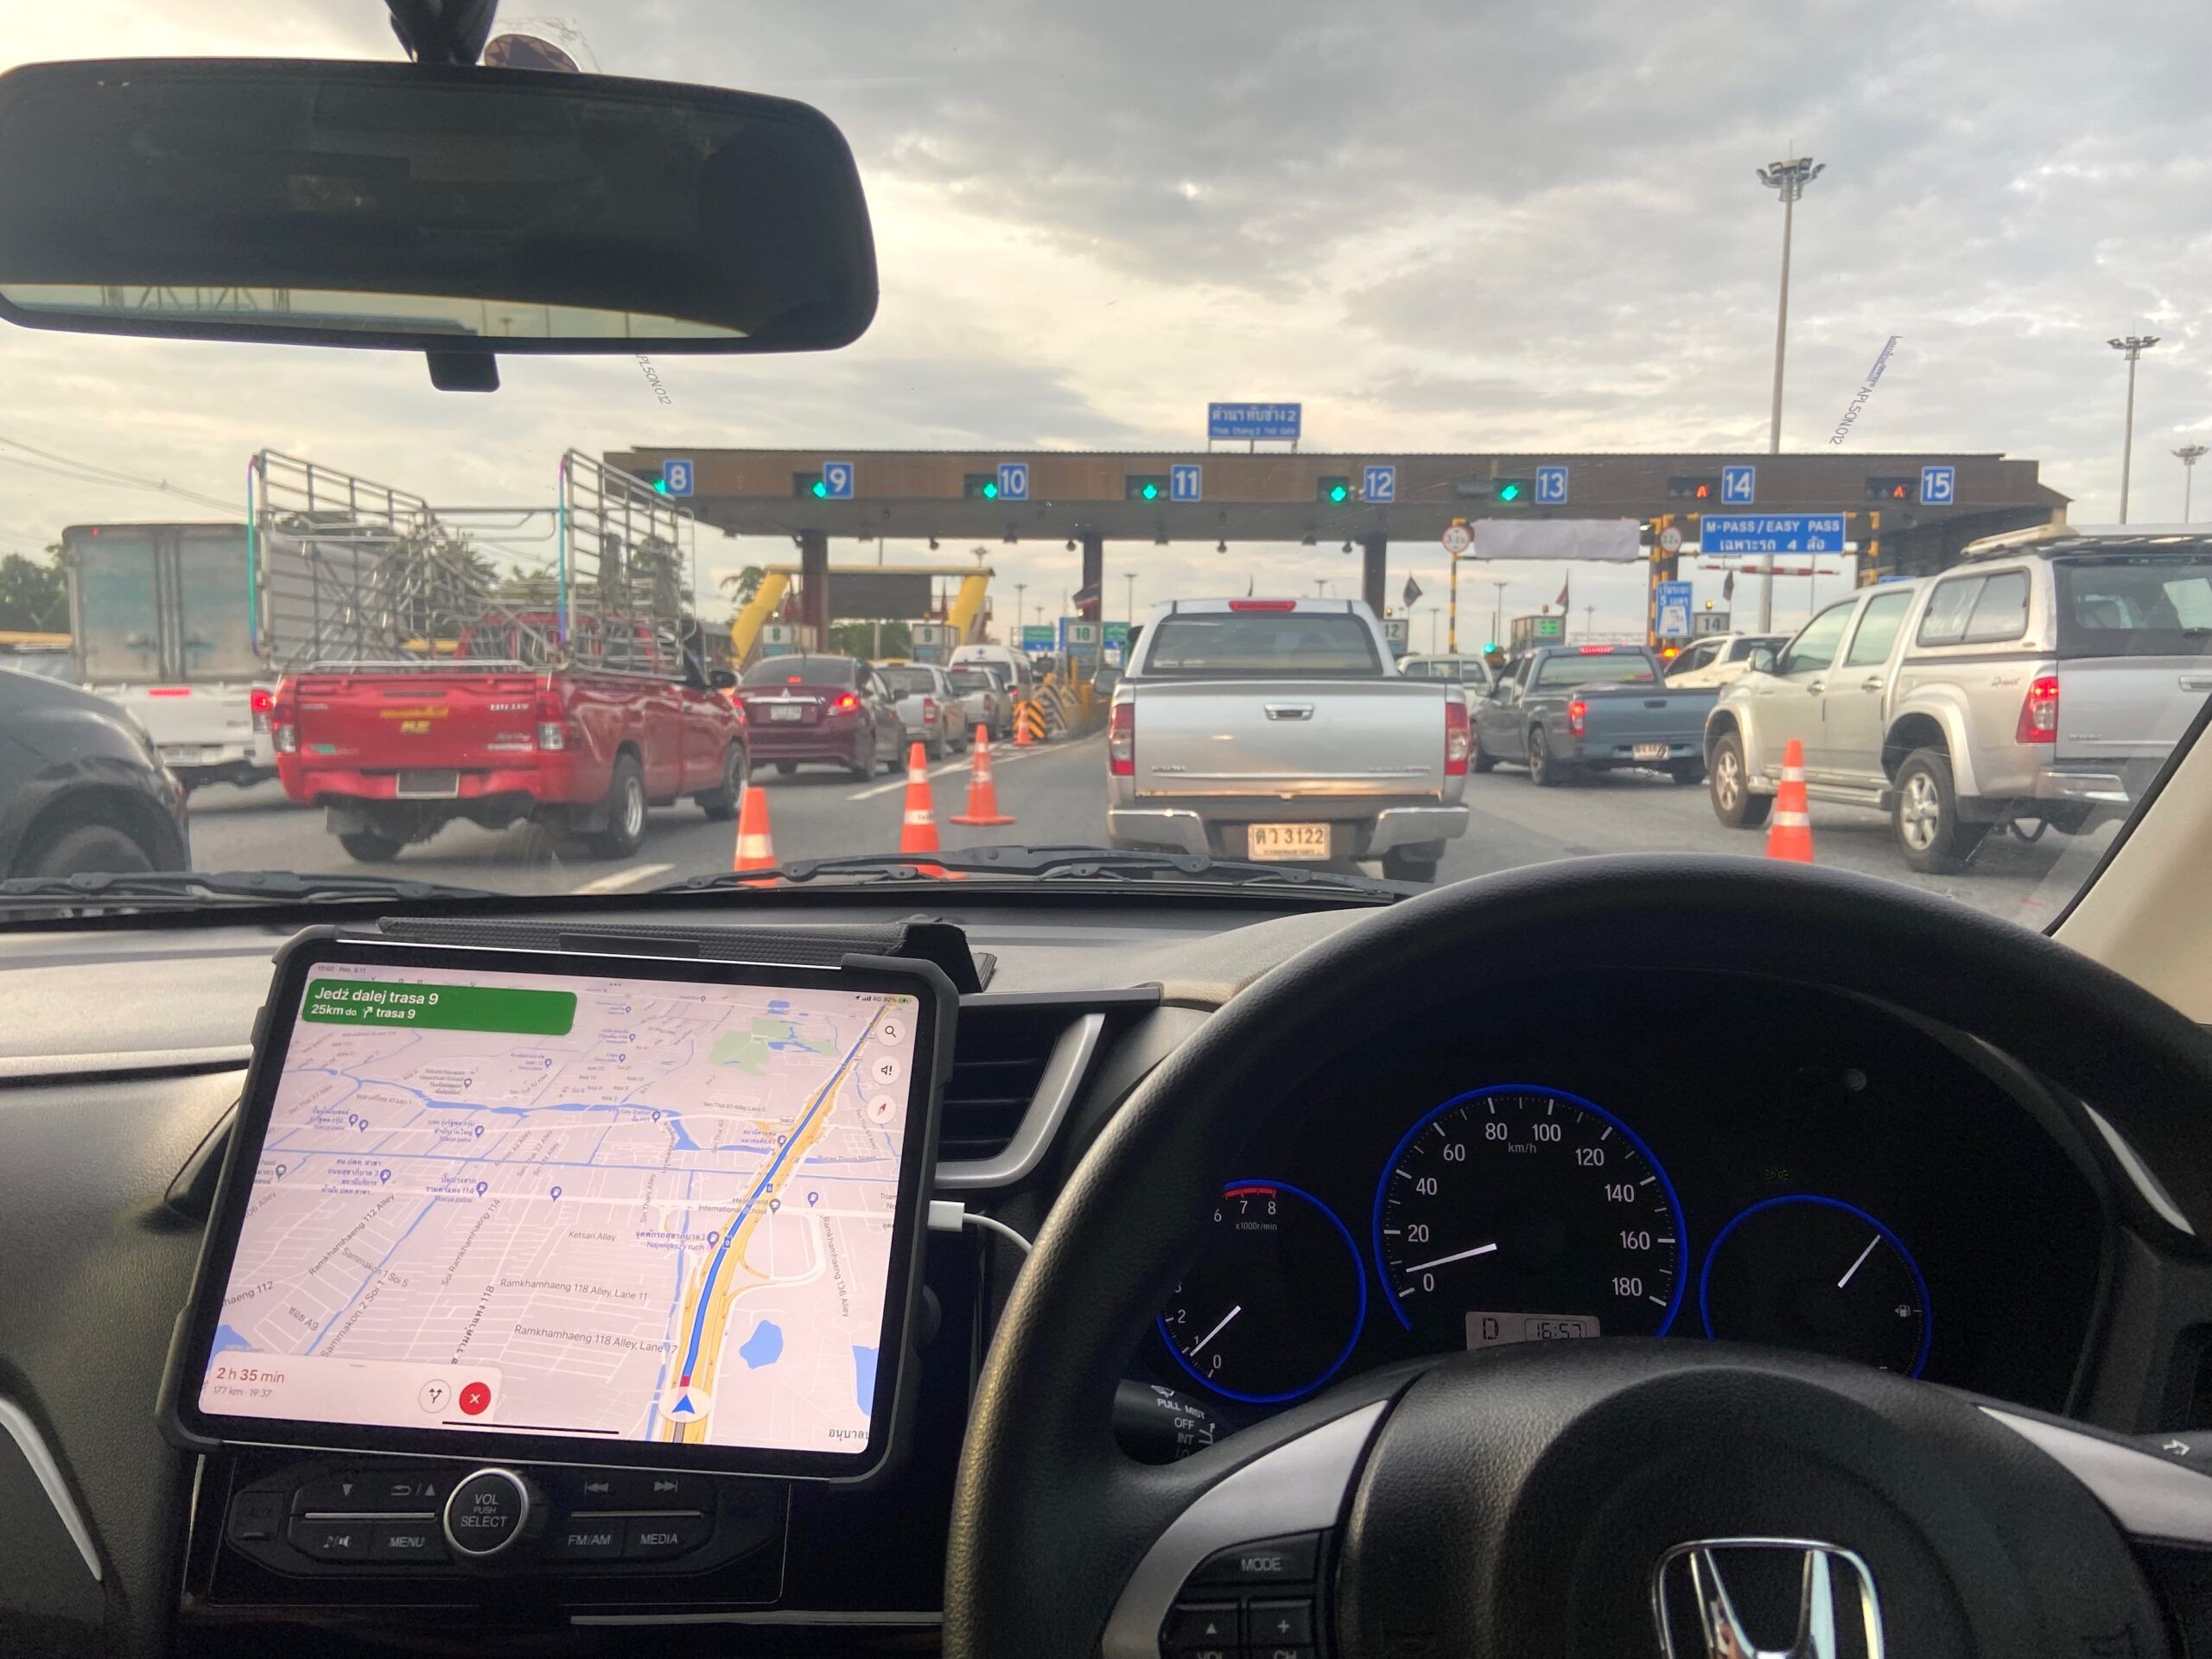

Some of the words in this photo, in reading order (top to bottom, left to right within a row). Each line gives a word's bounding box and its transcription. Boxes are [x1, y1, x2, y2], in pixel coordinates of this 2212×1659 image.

[670, 465, 687, 491] 8
[830, 467, 847, 493] 9
[1001, 469, 1026, 495] 10
[1175, 470, 1198, 497] 11
[1367, 472, 1393, 498] 12
[1540, 473, 1565, 499] 13
[1726, 472, 1751, 499] 14
[1924, 472, 1951, 499] 15
[1808, 520, 1840, 532] PASS
[1787, 539, 1797, 550] 4
[1705, 617, 1721, 632] 14
[1076, 627, 1090, 641] 10
[1285, 828, 1324, 844] 3122
[315, 987, 349, 1000] Jedź
[353, 989, 386, 1005] dalej
[390, 990, 425, 1004] trasa
[429, 992, 439, 1005] 9
[311, 1003, 344, 1015] 25km
[346, 1007, 357, 1016] do
[376, 1007, 404, 1019] trasa
[407, 1009, 416, 1019] 9
[1485, 1122, 1508, 1141] 80
[1532, 1123, 1561, 1142] 100
[1443, 1143, 1465, 1162] 60
[1508, 1141, 1537, 1154] km/h
[1575, 1147, 1605, 1166] 120
[1415, 1177, 1438, 1196] 40
[1605, 1184, 1635, 1203] 140
[1213, 1209, 1222, 1223] 6
[1240, 1200, 1249, 1215] 7
[1268, 1201, 1276, 1215] 8
[308, 1221, 365, 1275] Ramkhamhaeng
[363, 1209, 377, 1225] 112
[377, 1193, 396, 1211] Alley
[448, 1211, 490, 1271] Ramkhamhaeng
[487, 1198, 501, 1214] 114
[1235, 1221, 1278, 1231] x1000r/min
[1407, 1224, 1430, 1243] 20
[596, 1232, 617, 1243] Alley
[1620, 1230, 1650, 1250] 160
[342, 1247, 383, 1275] Sammakon
[257, 1280, 275, 1294] 112
[500, 1278, 571, 1293] Ramkhamhaeng
[574, 1283, 588, 1294] 118
[614, 1289, 636, 1300] Lane
[639, 1292, 648, 1300] 11
[837, 1280, 847, 1296] 136
[1422, 1274, 1434, 1292] 0
[1611, 1277, 1643, 1298] 180
[481, 1284, 494, 1303] 118
[303, 1317, 320, 1332] A9
[1177, 1309, 1186, 1325] 2
[321, 1311, 362, 1357] Sammakon
[1482, 1317, 1499, 1341] D
[1536, 1321, 1583, 1340] 16:57
[514, 1325, 592, 1344] Ramkhamhaeng
[594, 1334, 611, 1345] 118
[640, 1340, 664, 1353] Lane
[665, 1344, 678, 1355] 17
[1212, 1354, 1222, 1369] 0
[216, 1367, 226, 1380] 2
[229, 1368, 237, 1380] h
[240, 1369, 258, 1382] 35
[261, 1370, 285, 1383] min
[213, 1386, 228, 1395] 177
[229, 1386, 243, 1395] km
[1157, 1397, 1181, 1411] PULL
[1185, 1404, 1205, 1420] MIST
[1174, 1416, 1195, 1430] OFF
[1177, 1432, 1194, 1445] INT
[474, 1493, 499, 1506] VOL
[461, 1516, 508, 1529] SELECT
[389, 1536, 426, 1548] MENU
[568, 1533, 612, 1546] FM/AM
[640, 1533, 679, 1546] MEDIA
[1242, 1557, 1282, 1572] MODE
